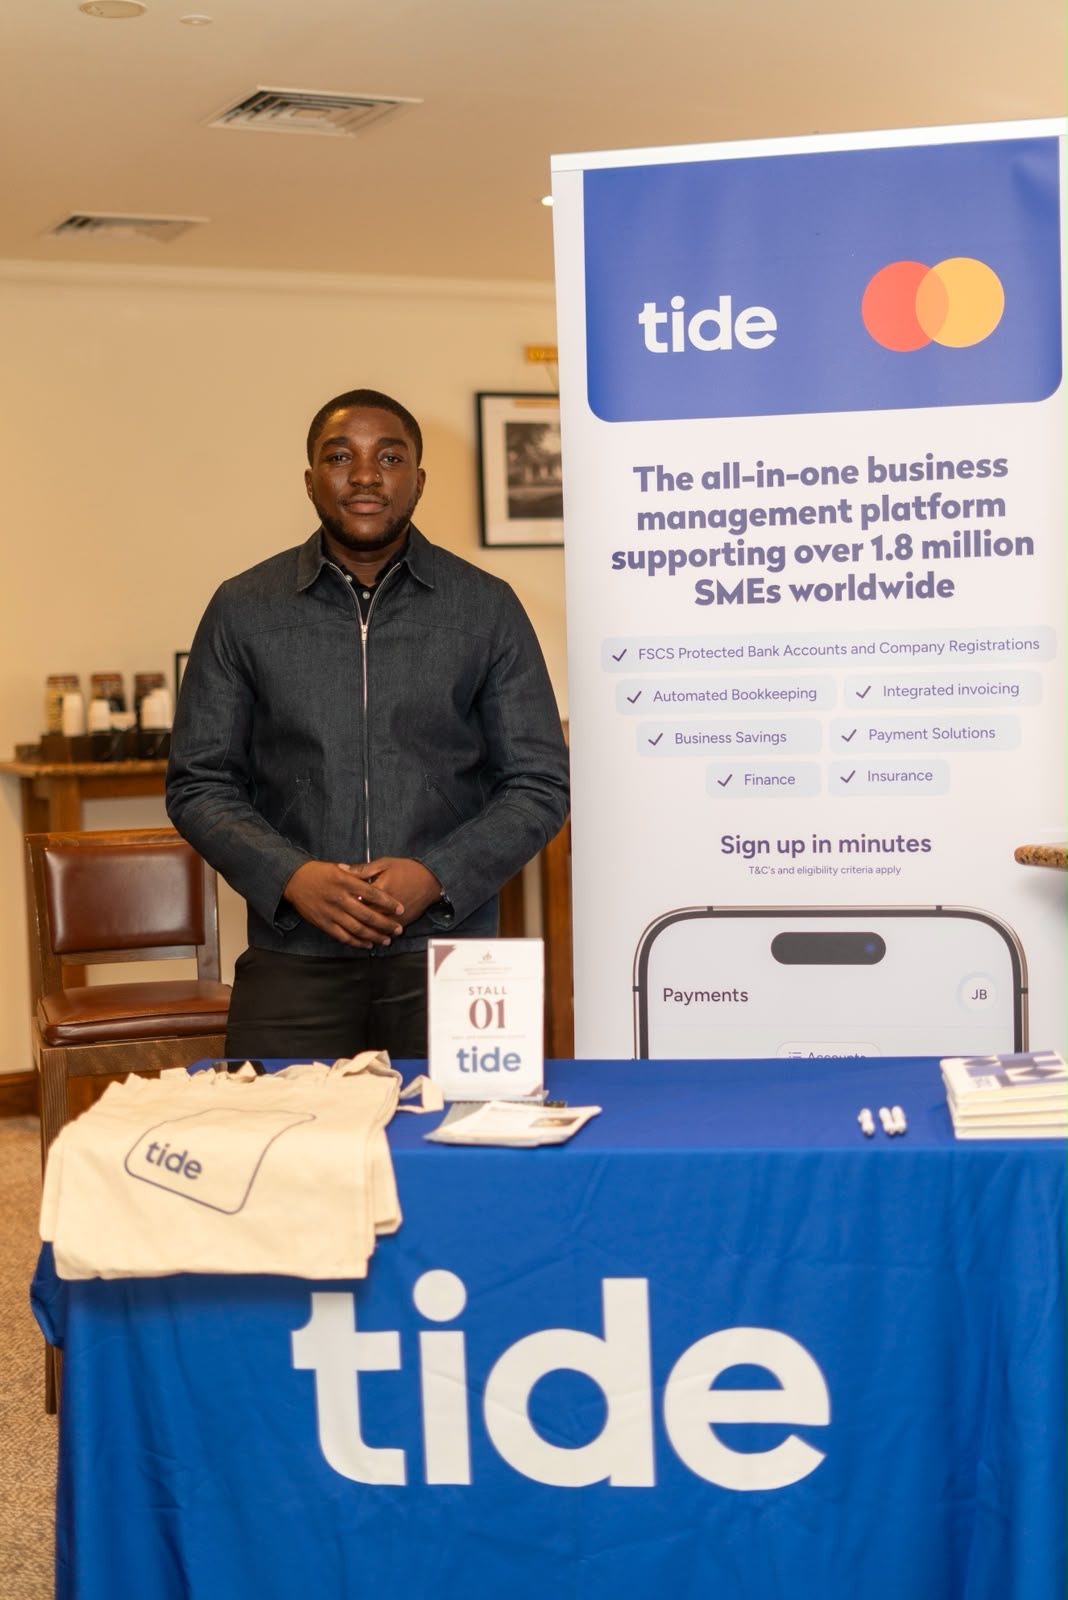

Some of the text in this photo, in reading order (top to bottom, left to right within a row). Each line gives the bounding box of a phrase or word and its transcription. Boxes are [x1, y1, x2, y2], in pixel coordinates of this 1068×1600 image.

[639, 295, 777, 353] tide
[633, 453, 1008, 492] The all-in-one business
[637, 492, 1006, 535] management platform
[611, 529, 1034, 576] supporting over 1.8 million
[695, 571, 955, 606] SMEs worldwide
[639, 638, 1040, 660] FSCS Protected Bank Accounts and Company Registrations
[653, 688, 817, 703] Automated Bookkeeping
[883, 682, 1020, 700] Integrated invoicing
[675, 731, 787, 746] Business Savings
[869, 727, 995, 744] Payment Solutions
[744, 774, 795, 786] Finance
[868, 770, 933, 782] Insurance
[720, 834, 931, 859] Sign up in minutes
[748, 865, 901, 876] T&C's and eligibility criteria apply
[469, 986, 507, 996] STALL
[663, 988, 748, 1006] Payments
[972, 989, 987, 1000] JB
[469, 998, 505, 1029] 01
[456, 1046, 521, 1072] tide
[145, 1140, 203, 1180] tide
[289, 1267, 830, 1491] tide
